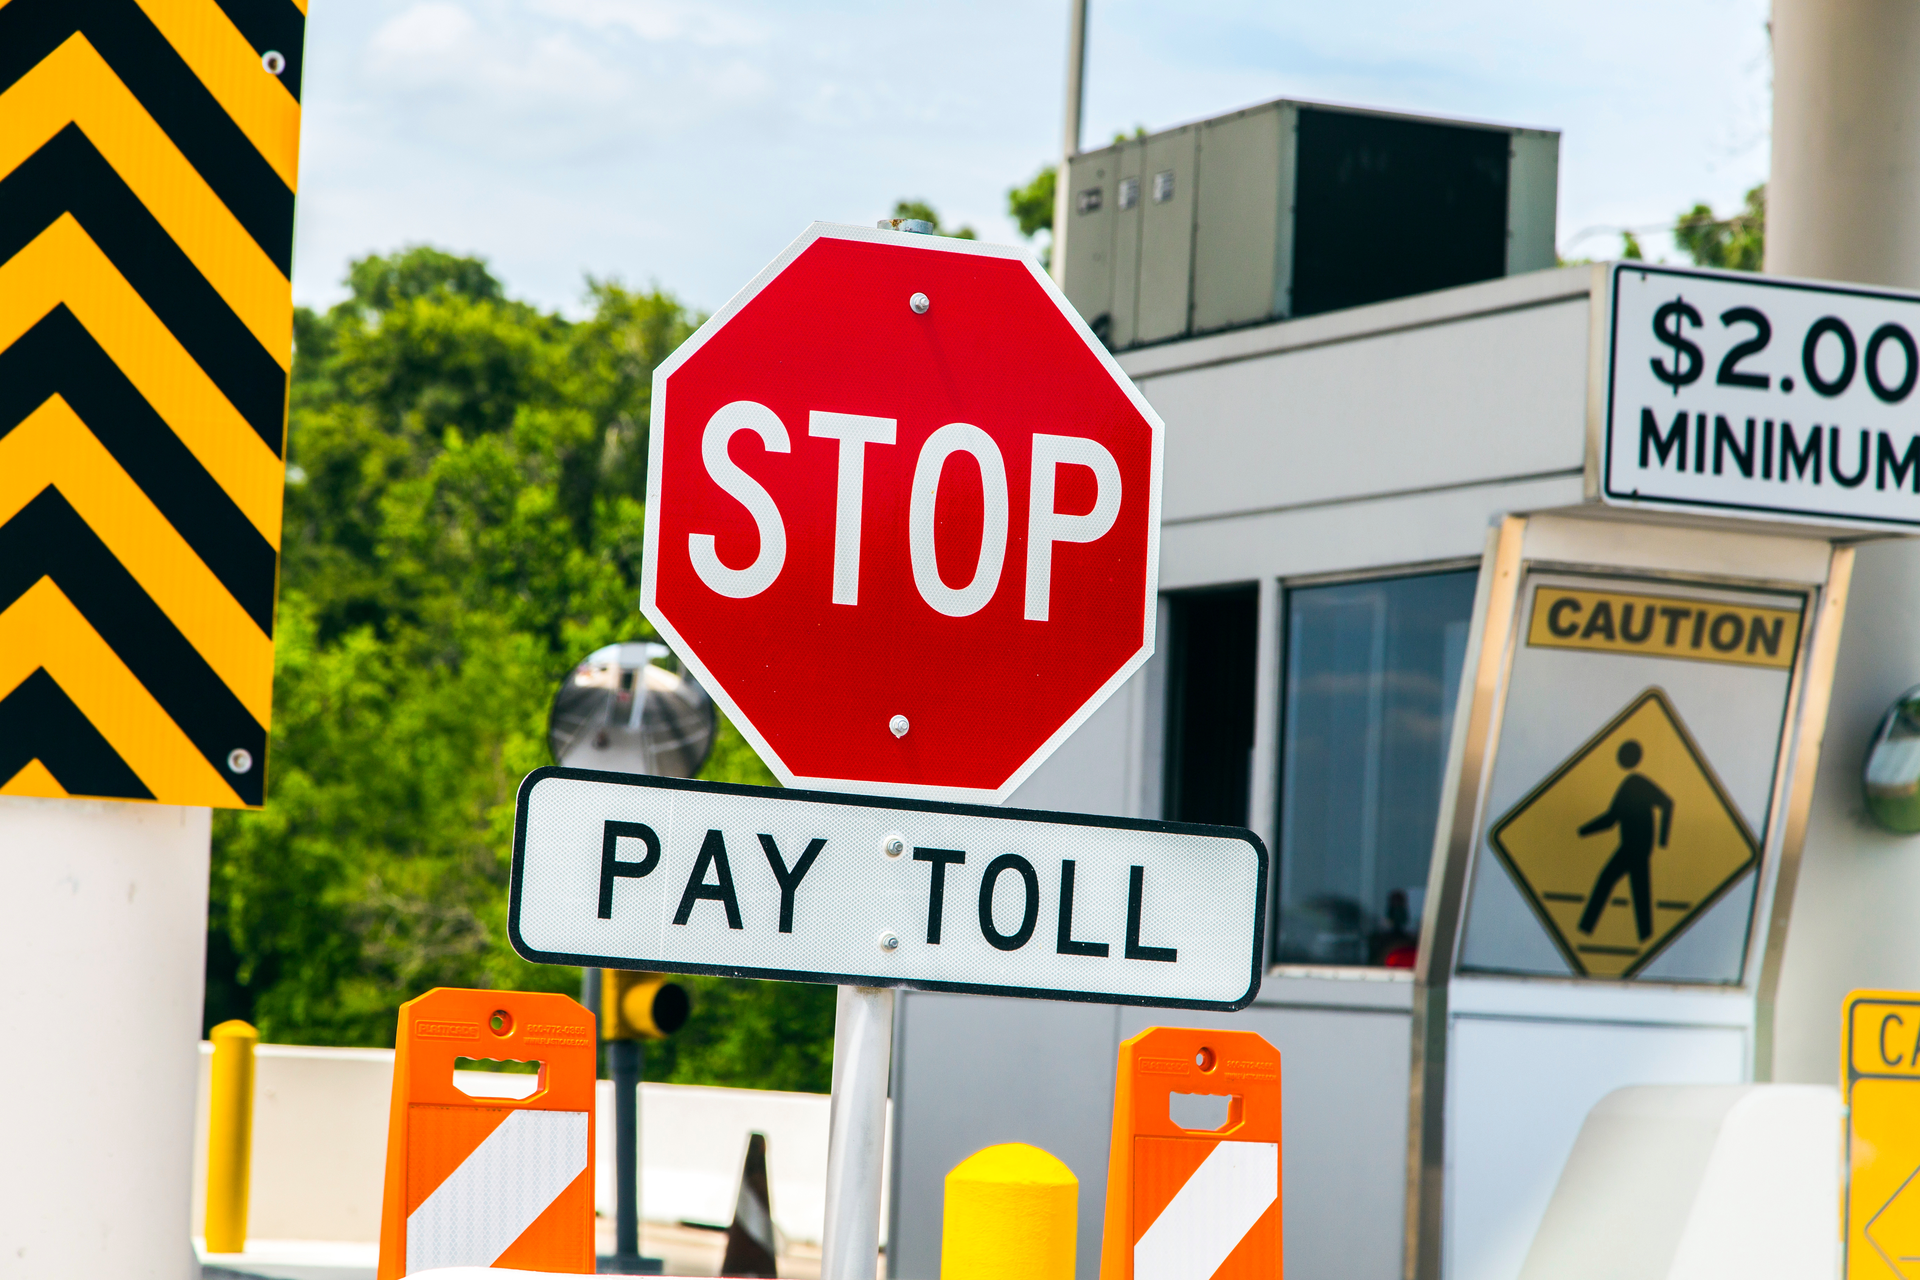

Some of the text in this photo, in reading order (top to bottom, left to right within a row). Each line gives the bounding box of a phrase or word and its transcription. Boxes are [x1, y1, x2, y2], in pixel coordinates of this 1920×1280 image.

[1649, 294, 1920, 405] $2.00
[1638, 406, 1920, 494] MINIMUM
[688, 400, 1122, 622] STOP
[1546, 596, 1785, 657] CAUTION
[597, 820, 1178, 963] PAY TOLL
